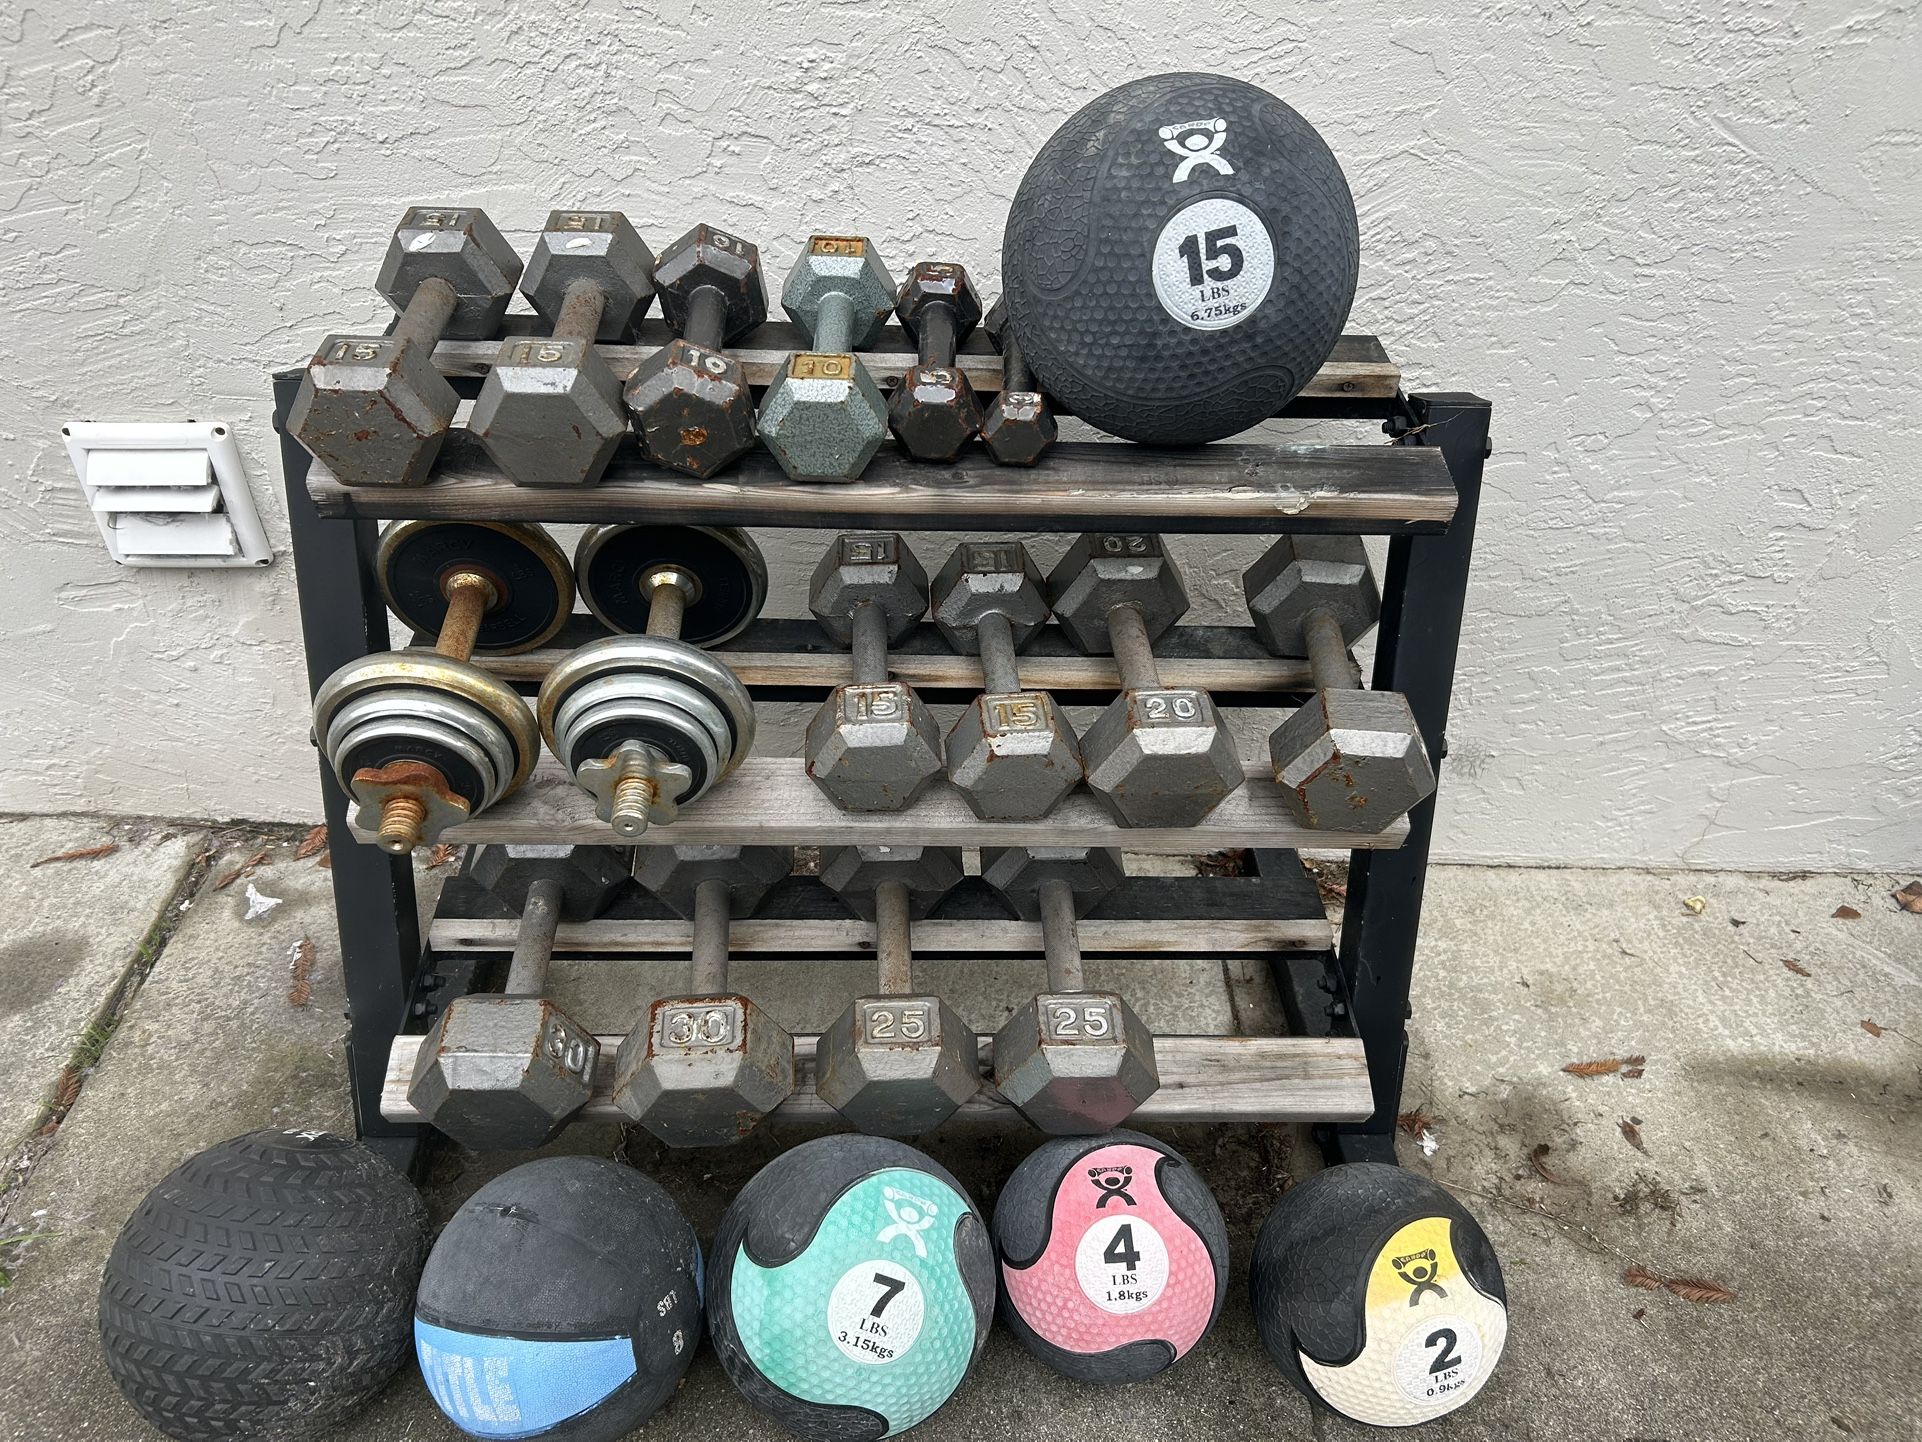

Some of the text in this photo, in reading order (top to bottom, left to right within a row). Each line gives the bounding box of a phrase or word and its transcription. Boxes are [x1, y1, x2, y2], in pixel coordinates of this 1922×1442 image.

[1178, 224, 1243, 287] 15
[1199, 284, 1230, 303] LBS
[1190, 302, 1247, 321] 6.75kgs
[334, 343, 382, 361] 15
[519, 344, 563, 365] 15
[688, 349, 727, 375] 10
[801, 359, 843, 376] 10
[1102, 535, 1148, 552] 20
[854, 691, 898, 720] 15
[994, 702, 1037, 727] 15
[1145, 697, 1196, 720] 20
[669, 1009, 730, 1044] 30
[870, 1010, 926, 1039] 25
[1052, 1007, 1109, 1037] 25
[549, 1007, 585, 1074] 30
[1103, 1224, 1141, 1272] 4
[1112, 1273, 1138, 1286] LBS
[870, 1272, 906, 1319] 7
[1106, 1290, 1149, 1302] 1.8kgs
[859, 1318, 889, 1338] LBS
[838, 1330, 894, 1360] 3.15kgs
[1424, 1328, 1462, 1375] 2
[420, 1340, 522, 1421] TITLE
[1434, 1367, 1459, 1385] LBS
